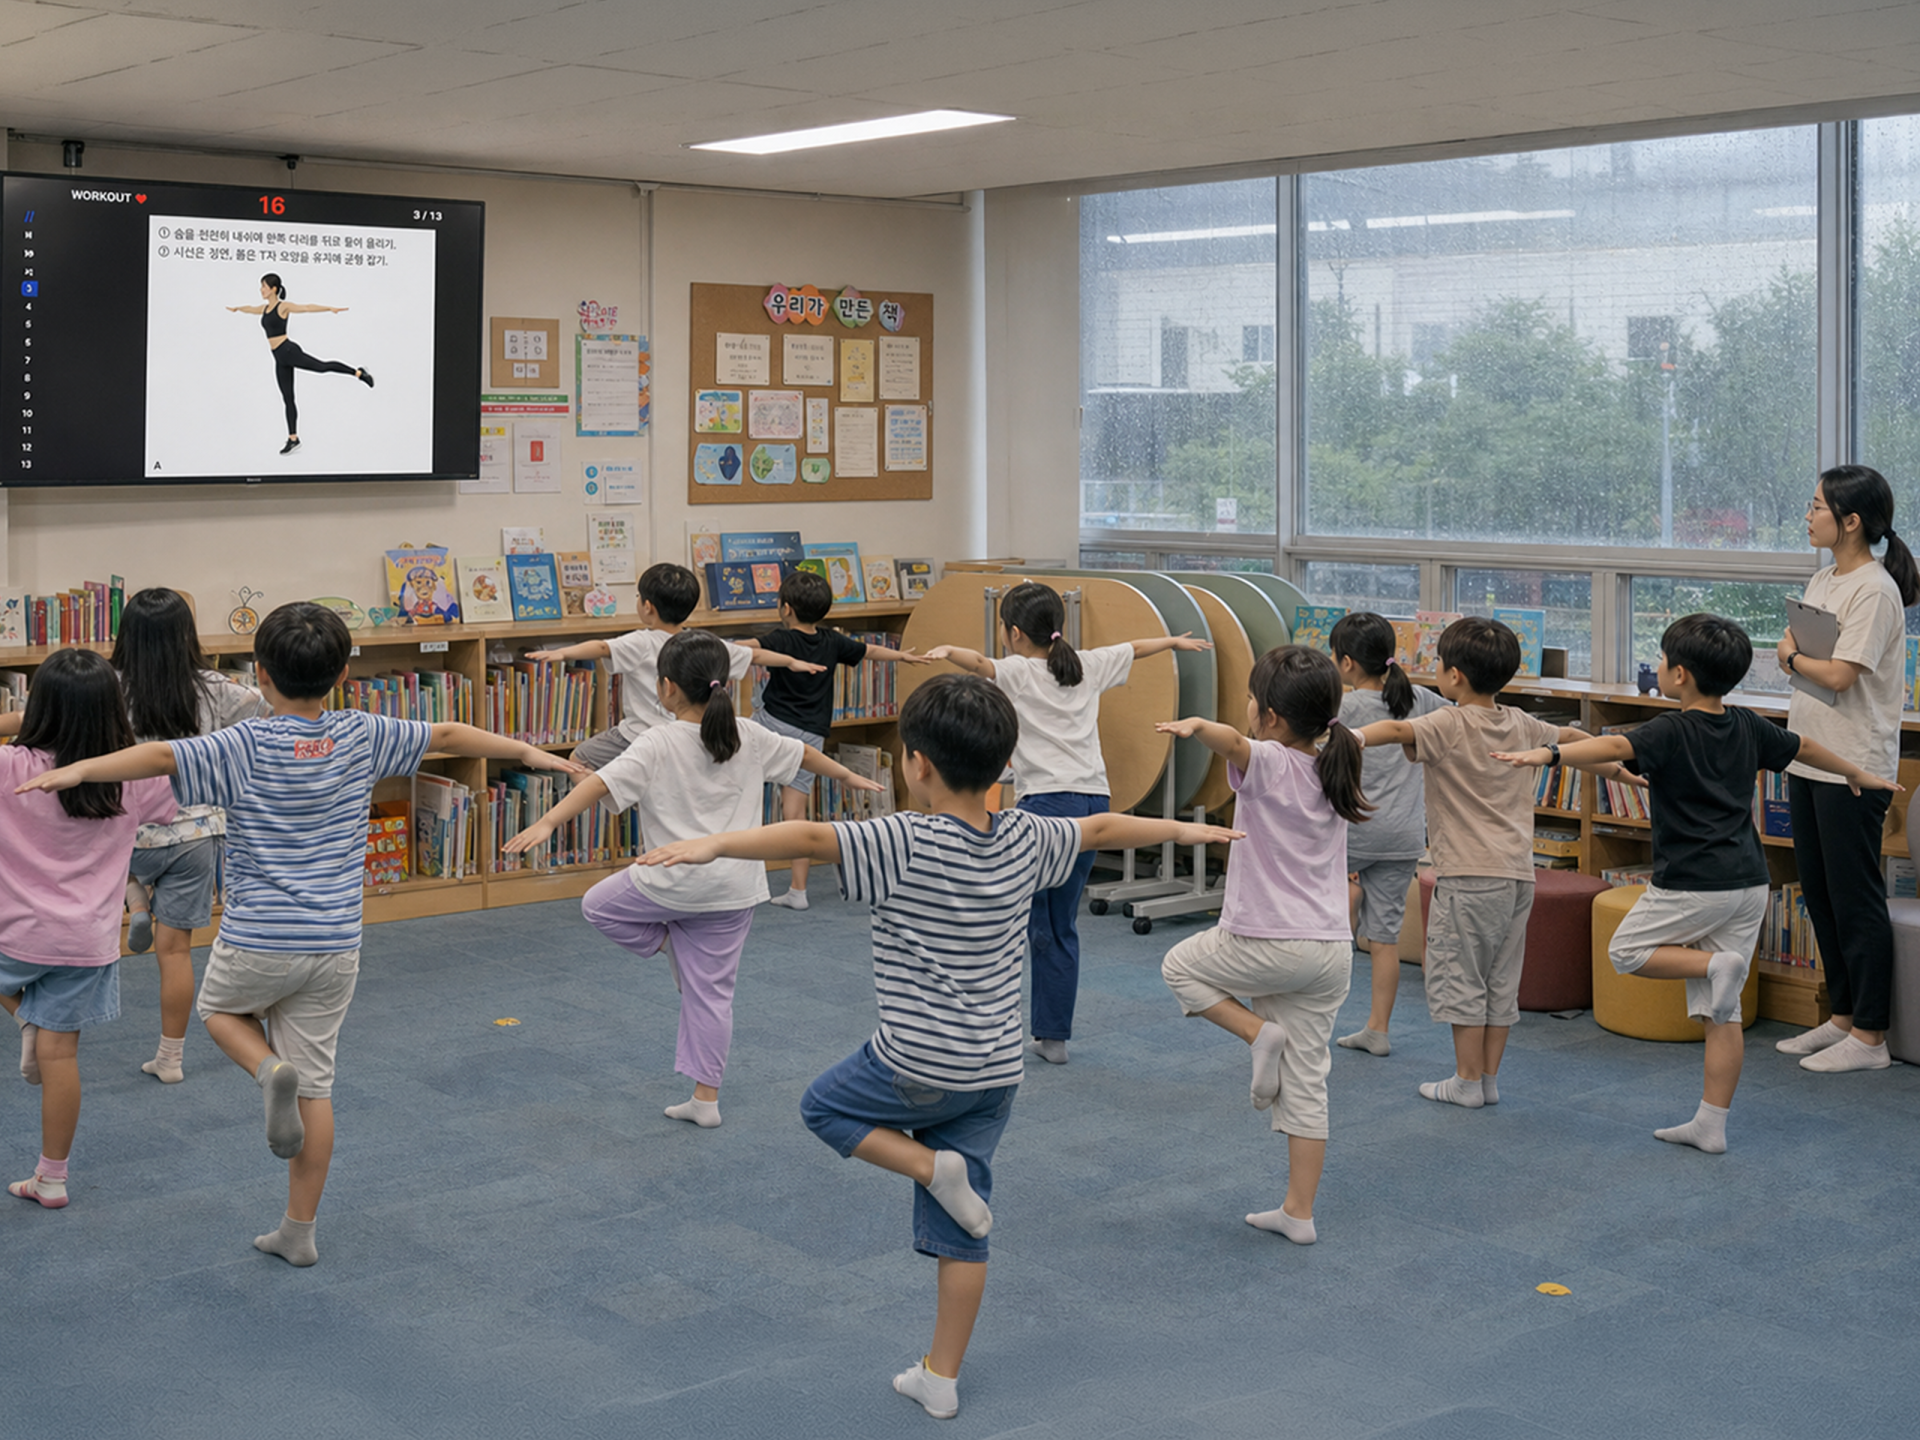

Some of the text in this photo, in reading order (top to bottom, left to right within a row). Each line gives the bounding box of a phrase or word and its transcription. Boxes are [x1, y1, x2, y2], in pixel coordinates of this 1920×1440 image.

[71, 189, 132, 202] WORKOUT
[259, 195, 286, 215] 16
[25, 302, 32, 311] 4
[771, 293, 898, 323] 우리가 만든 책
[24, 355, 31, 365] 7
[24, 373, 31, 383] 8
[24, 391, 31, 400] 9
[22, 409, 33, 418] 10
[22, 426, 32, 434] 11
[22, 443, 32, 452] 12
[21, 460, 32, 469] 13
[154, 461, 162, 471] A
